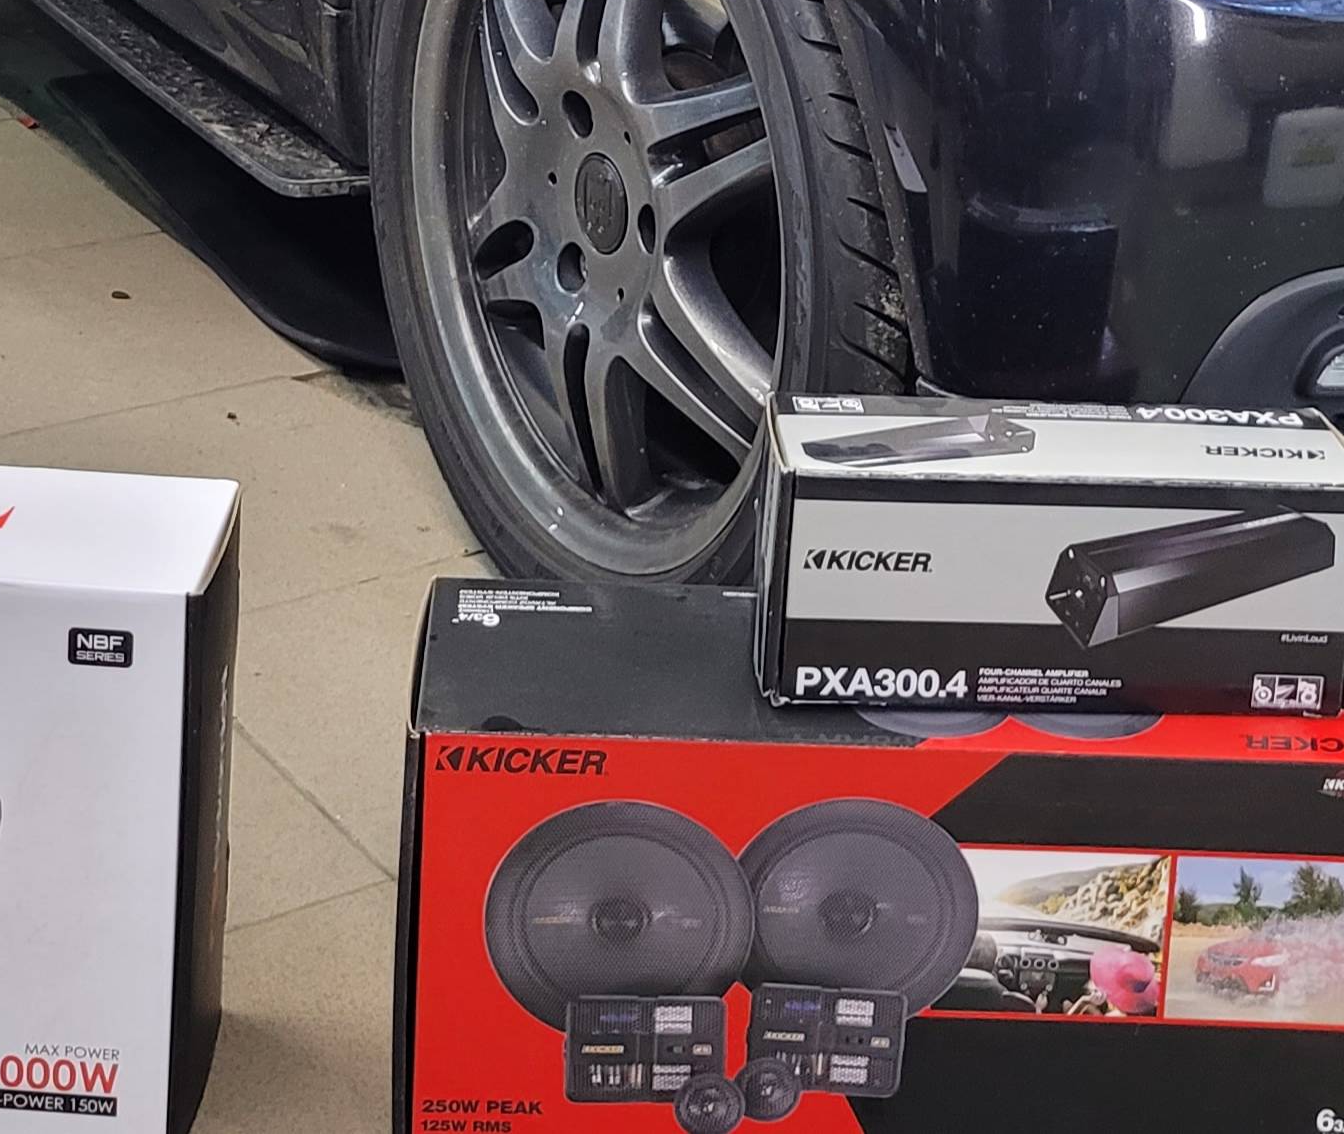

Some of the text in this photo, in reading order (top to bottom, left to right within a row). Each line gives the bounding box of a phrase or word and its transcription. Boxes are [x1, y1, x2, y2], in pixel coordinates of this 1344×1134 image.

[1205, 445, 1303, 460] KICKER
[825, 549, 931, 573] KICKER
[76, 633, 124, 651] NBF
[76, 650, 124, 663] SERIES
[1045, 669, 1089, 678] AMPLIFIER
[795, 666, 969, 698] PXA300.4
[1038, 678, 1049, 686] DE
[1085, 679, 1122, 688] CANALES
[466, 746, 608, 775] KICKER
[24, 1043, 120, 1061] MAX POWER
[70, 1098, 114, 1114] 150W
[422, 1099, 543, 1115] 250W PEAK
[421, 1120, 511, 1133] 125W RMS
